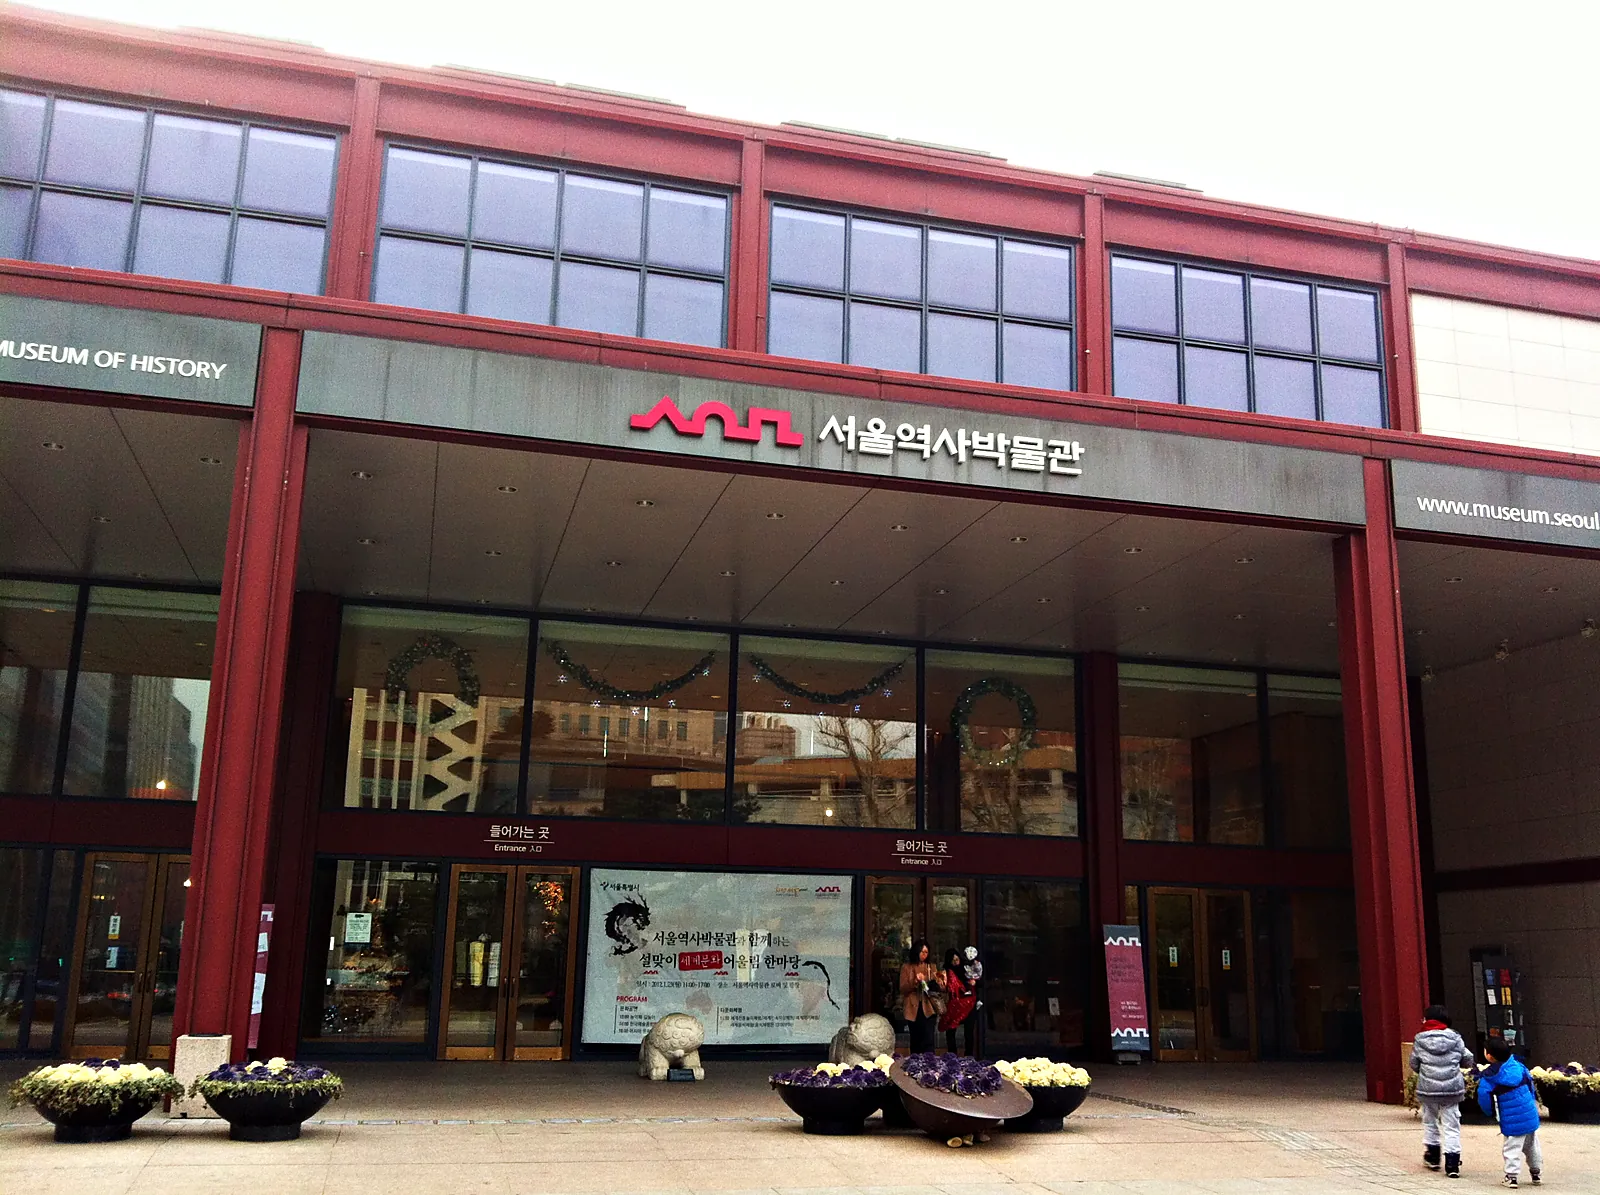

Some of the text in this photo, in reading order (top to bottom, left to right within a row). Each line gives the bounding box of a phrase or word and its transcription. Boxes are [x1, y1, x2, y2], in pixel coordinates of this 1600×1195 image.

[94, 350, 126, 369] OF
[130, 353, 228, 380] HISTORY
[818, 414, 1086, 476] 서울역사박물관
[1416, 496, 1600, 531] www.museum.seoul
[490, 825, 550, 840] 들어가는 곳
[494, 844, 543, 853] Entrance 入口
[895, 839, 948, 854] 들어가는 곳
[900, 857, 929, 866] Entrance
[609, 883, 640, 892] 서울특별시
[653, 931, 790, 948] 서울역사박물관과 함께하는
[640, 953, 802, 970] 설맞이 세계문화 어울림 한마당
[616, 995, 649, 1003] PROGRAM
